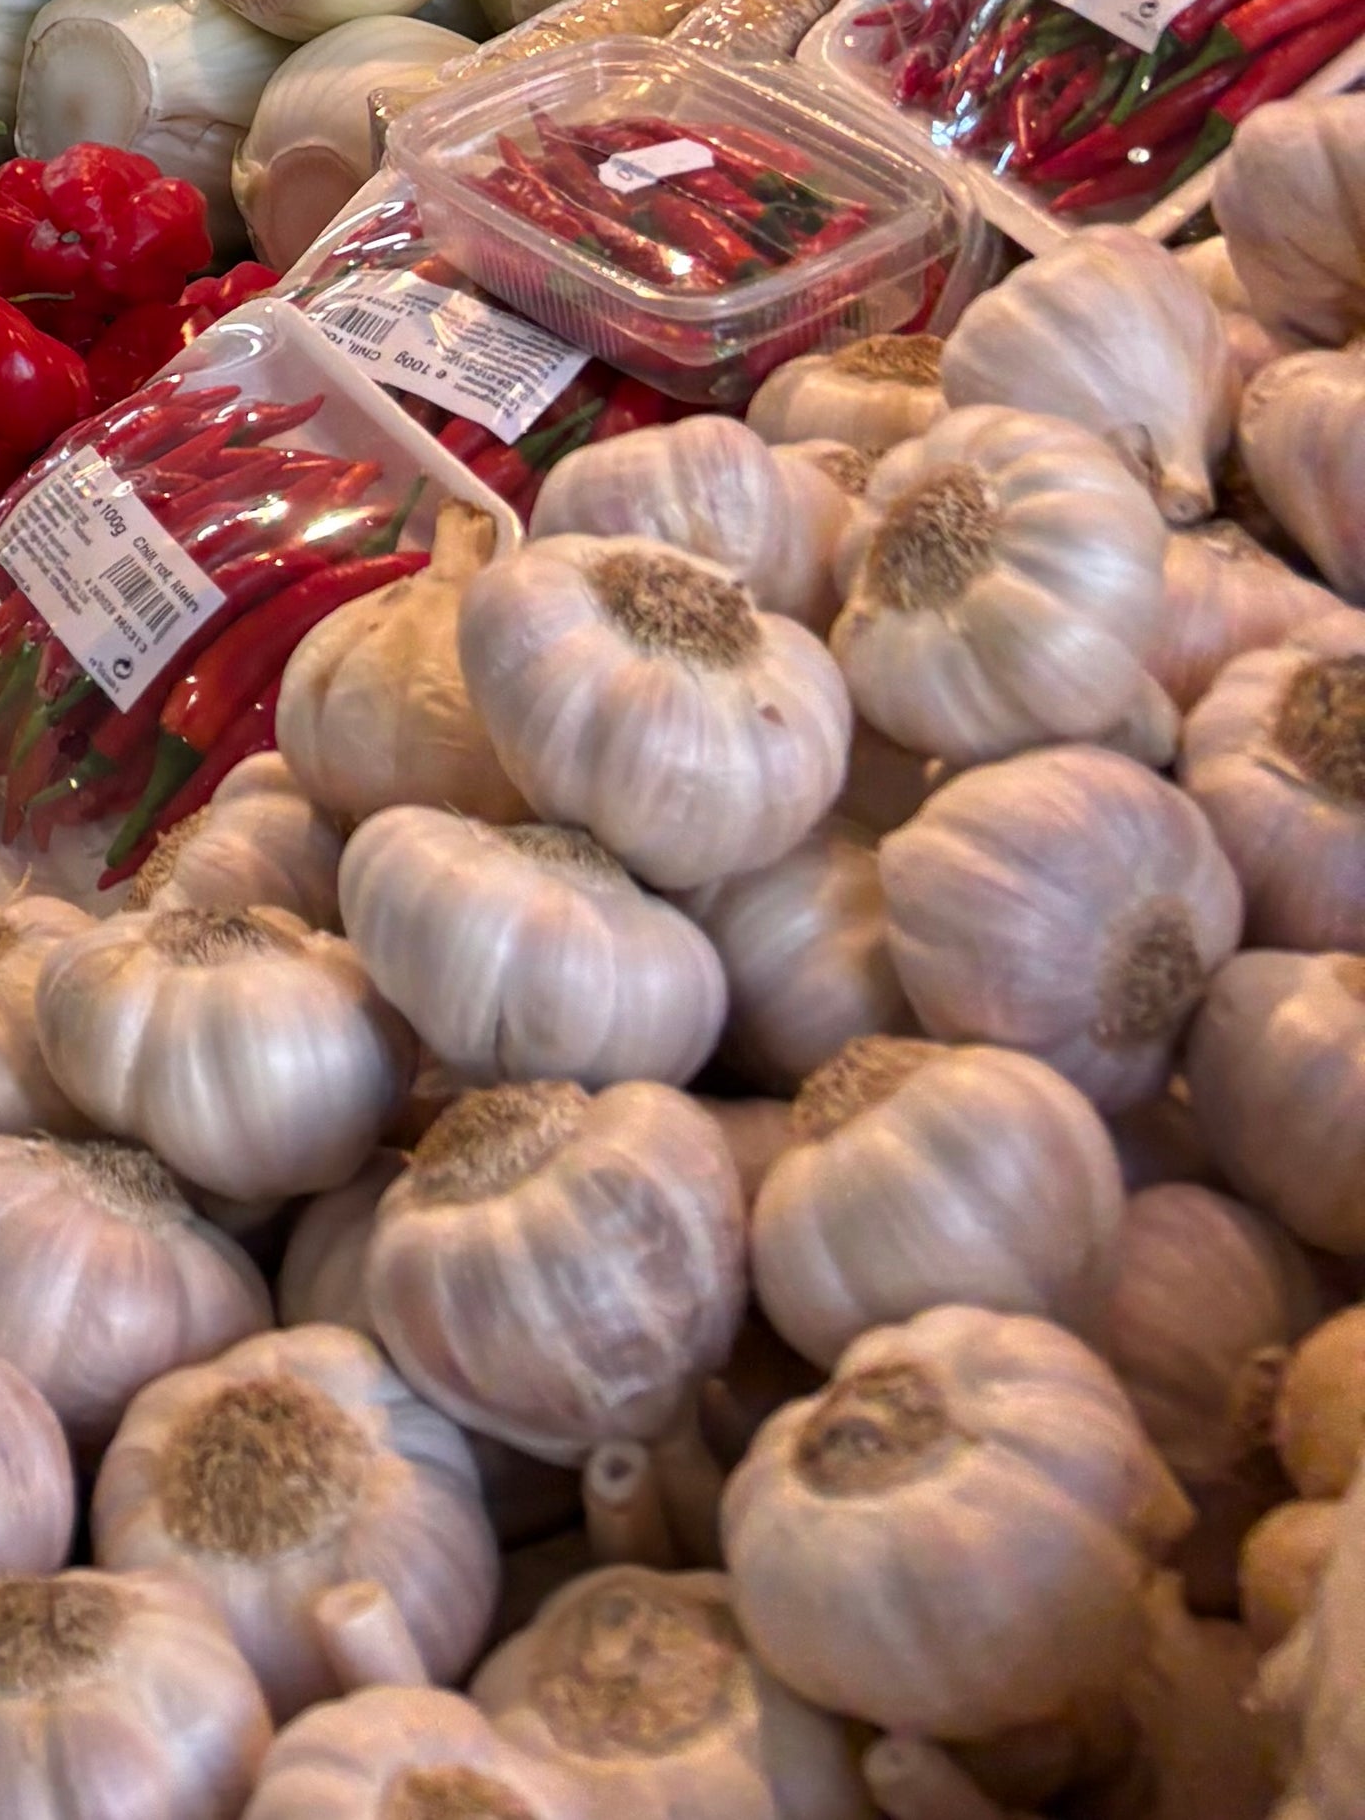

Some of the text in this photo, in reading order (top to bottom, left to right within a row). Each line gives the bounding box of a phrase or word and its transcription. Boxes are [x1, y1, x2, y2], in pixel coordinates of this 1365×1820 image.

[348, 337, 381, 361] Chili,
[394, 348, 430, 376] 100g
[99, 503, 127, 538] 100g
